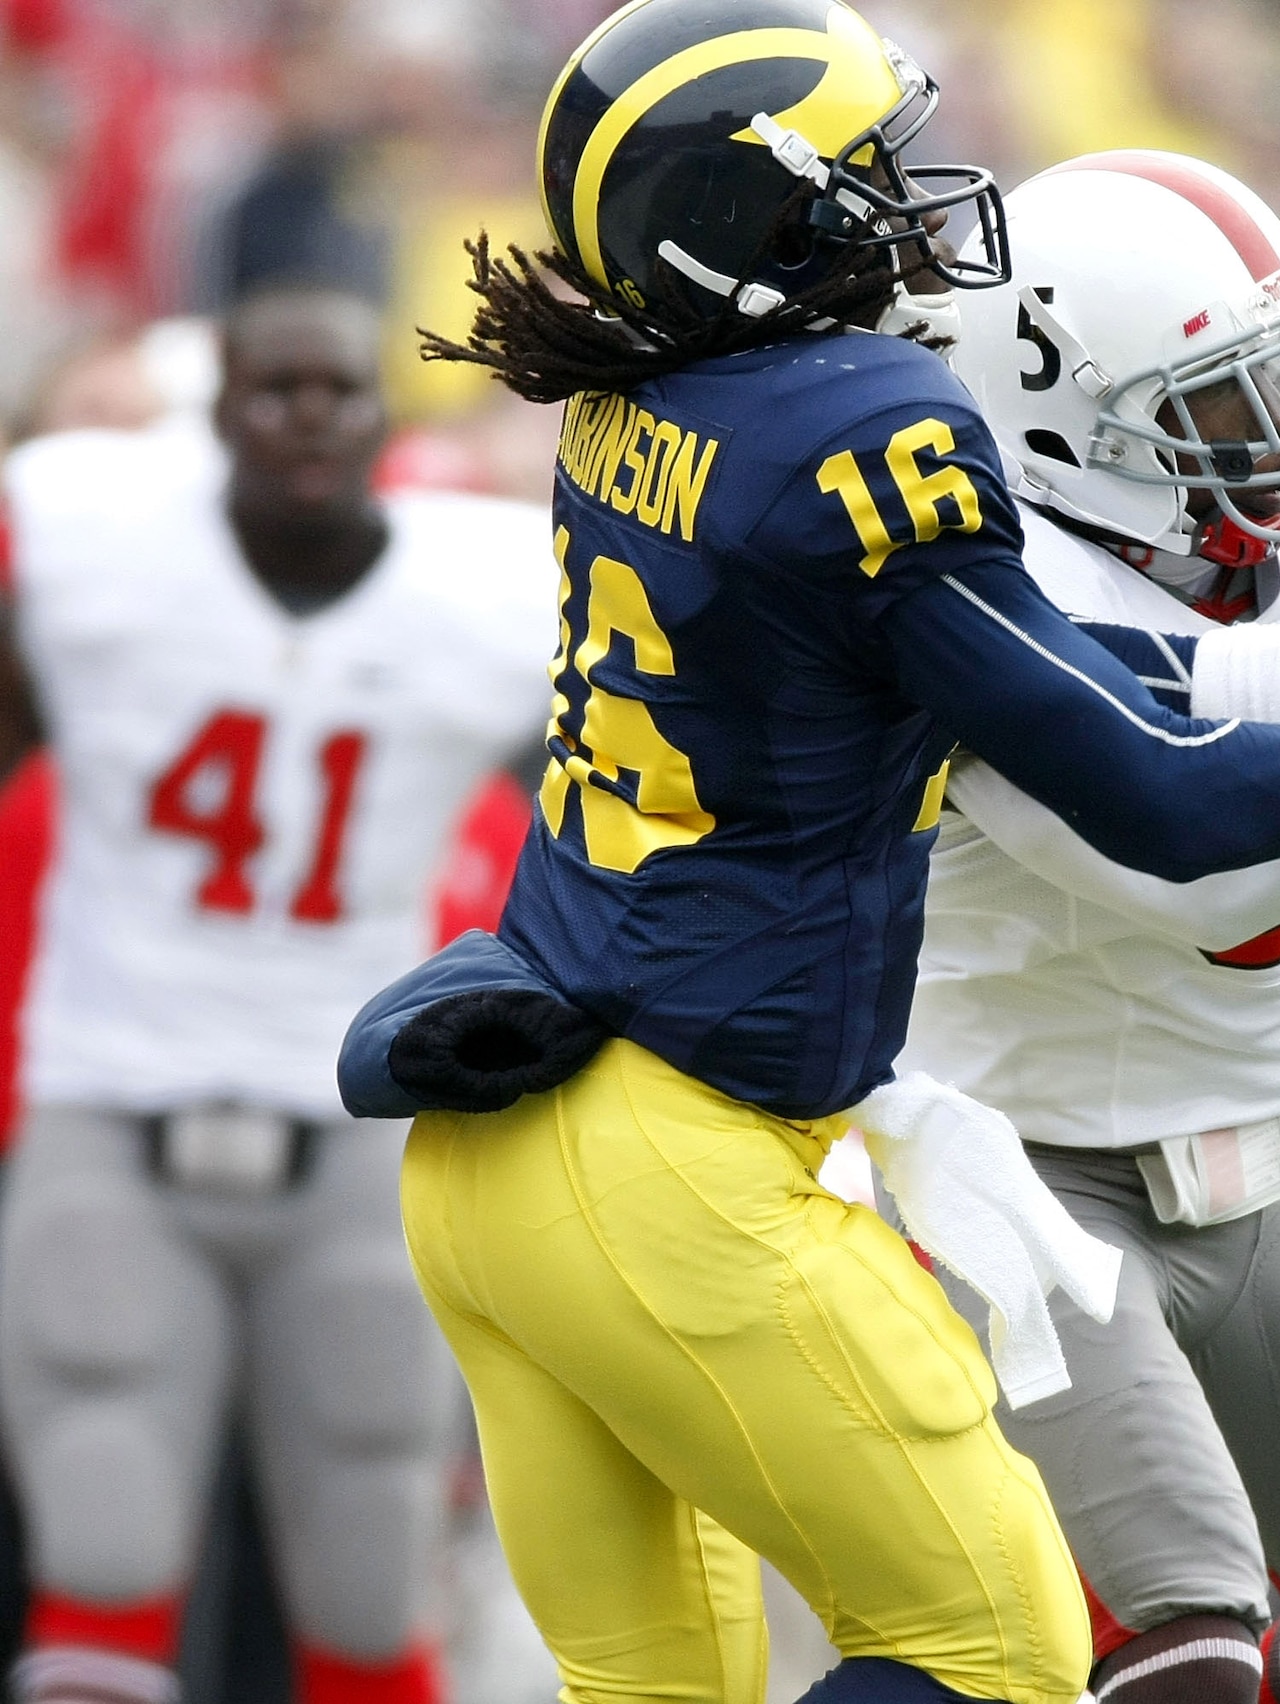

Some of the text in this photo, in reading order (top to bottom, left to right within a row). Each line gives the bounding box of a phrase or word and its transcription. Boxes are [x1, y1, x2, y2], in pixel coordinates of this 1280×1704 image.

[615, 279, 646, 309] 16
[1015, 287, 1062, 391] 5
[1182, 309, 1212, 338] NIKE
[556, 390, 719, 543] OBINSON
[815, 417, 983, 578] 16
[148, 706, 366, 922] 41
